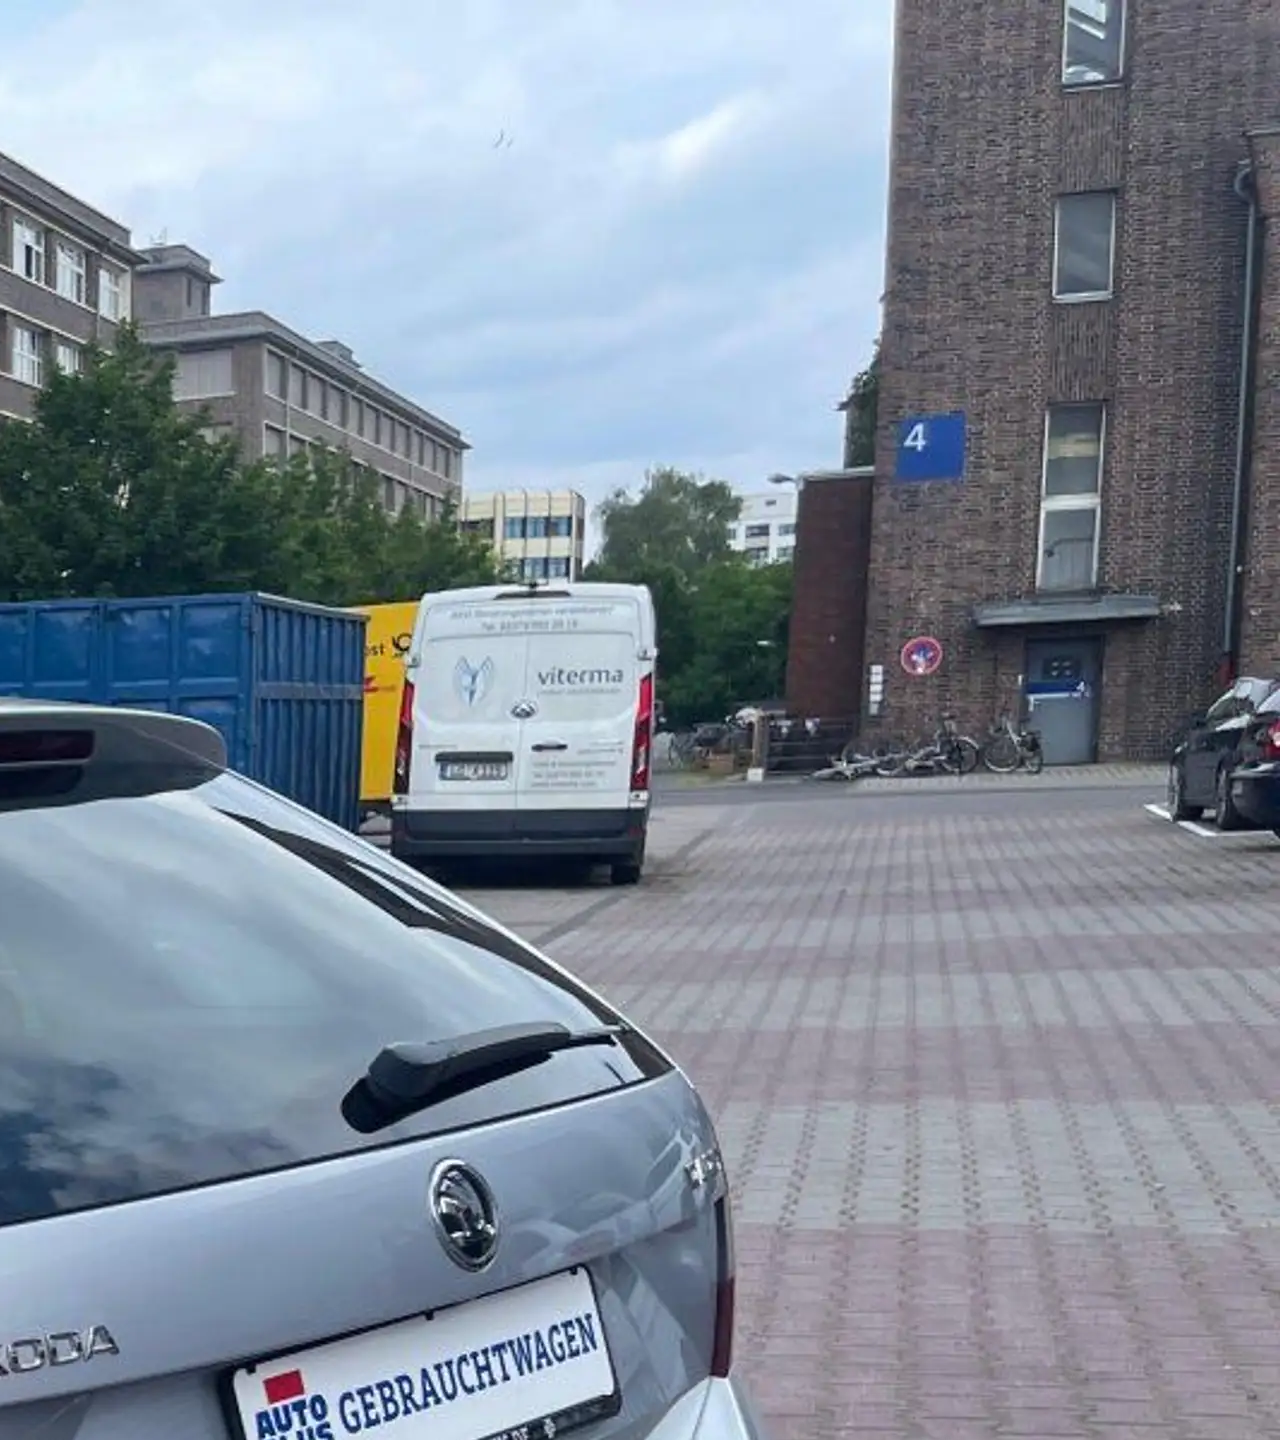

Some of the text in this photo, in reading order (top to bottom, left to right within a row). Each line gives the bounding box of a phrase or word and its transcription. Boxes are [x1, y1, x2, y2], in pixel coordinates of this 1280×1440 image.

[903, 422, 926, 452] 4
[538, 666, 625, 686] viterma
[339, 1313, 598, 1434] GEBRAUCHTWAGEN
